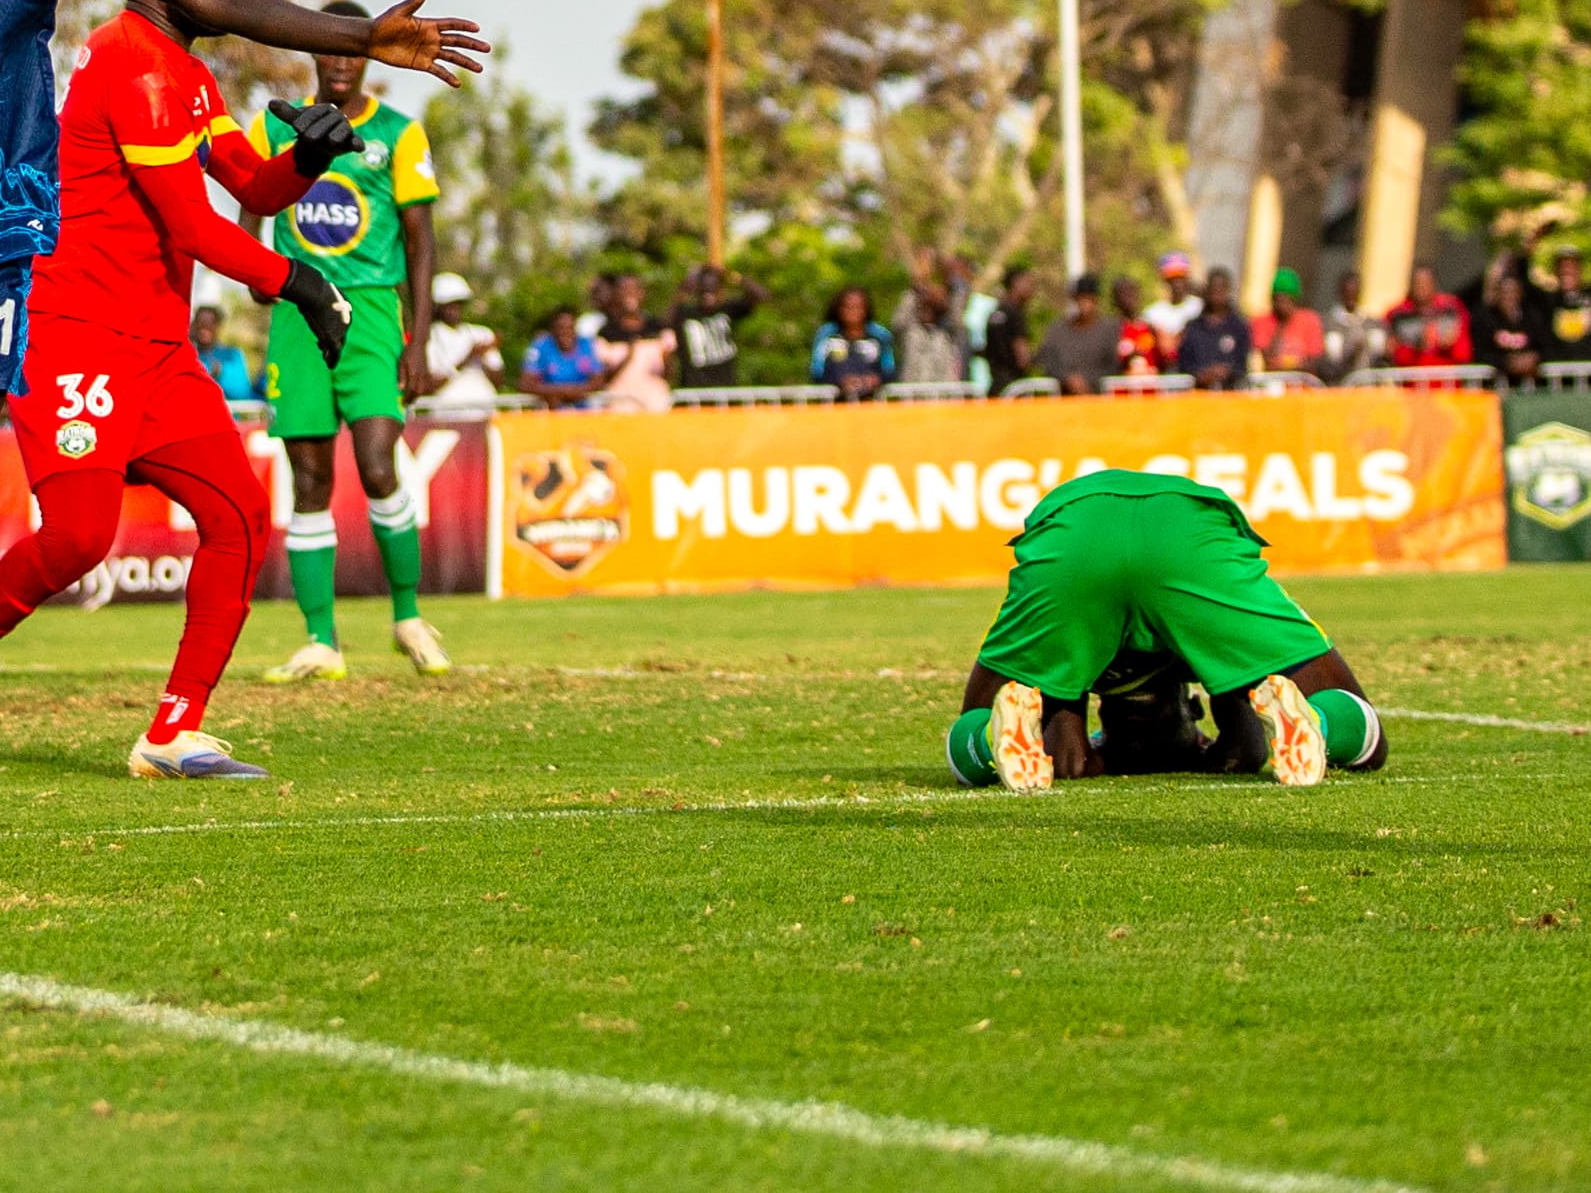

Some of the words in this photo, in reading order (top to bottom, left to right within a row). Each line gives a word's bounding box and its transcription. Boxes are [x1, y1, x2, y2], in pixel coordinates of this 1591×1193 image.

[296, 202, 360, 226] HASS
[55, 372, 114, 419] 36
[652, 457, 1110, 539] MURANG'
